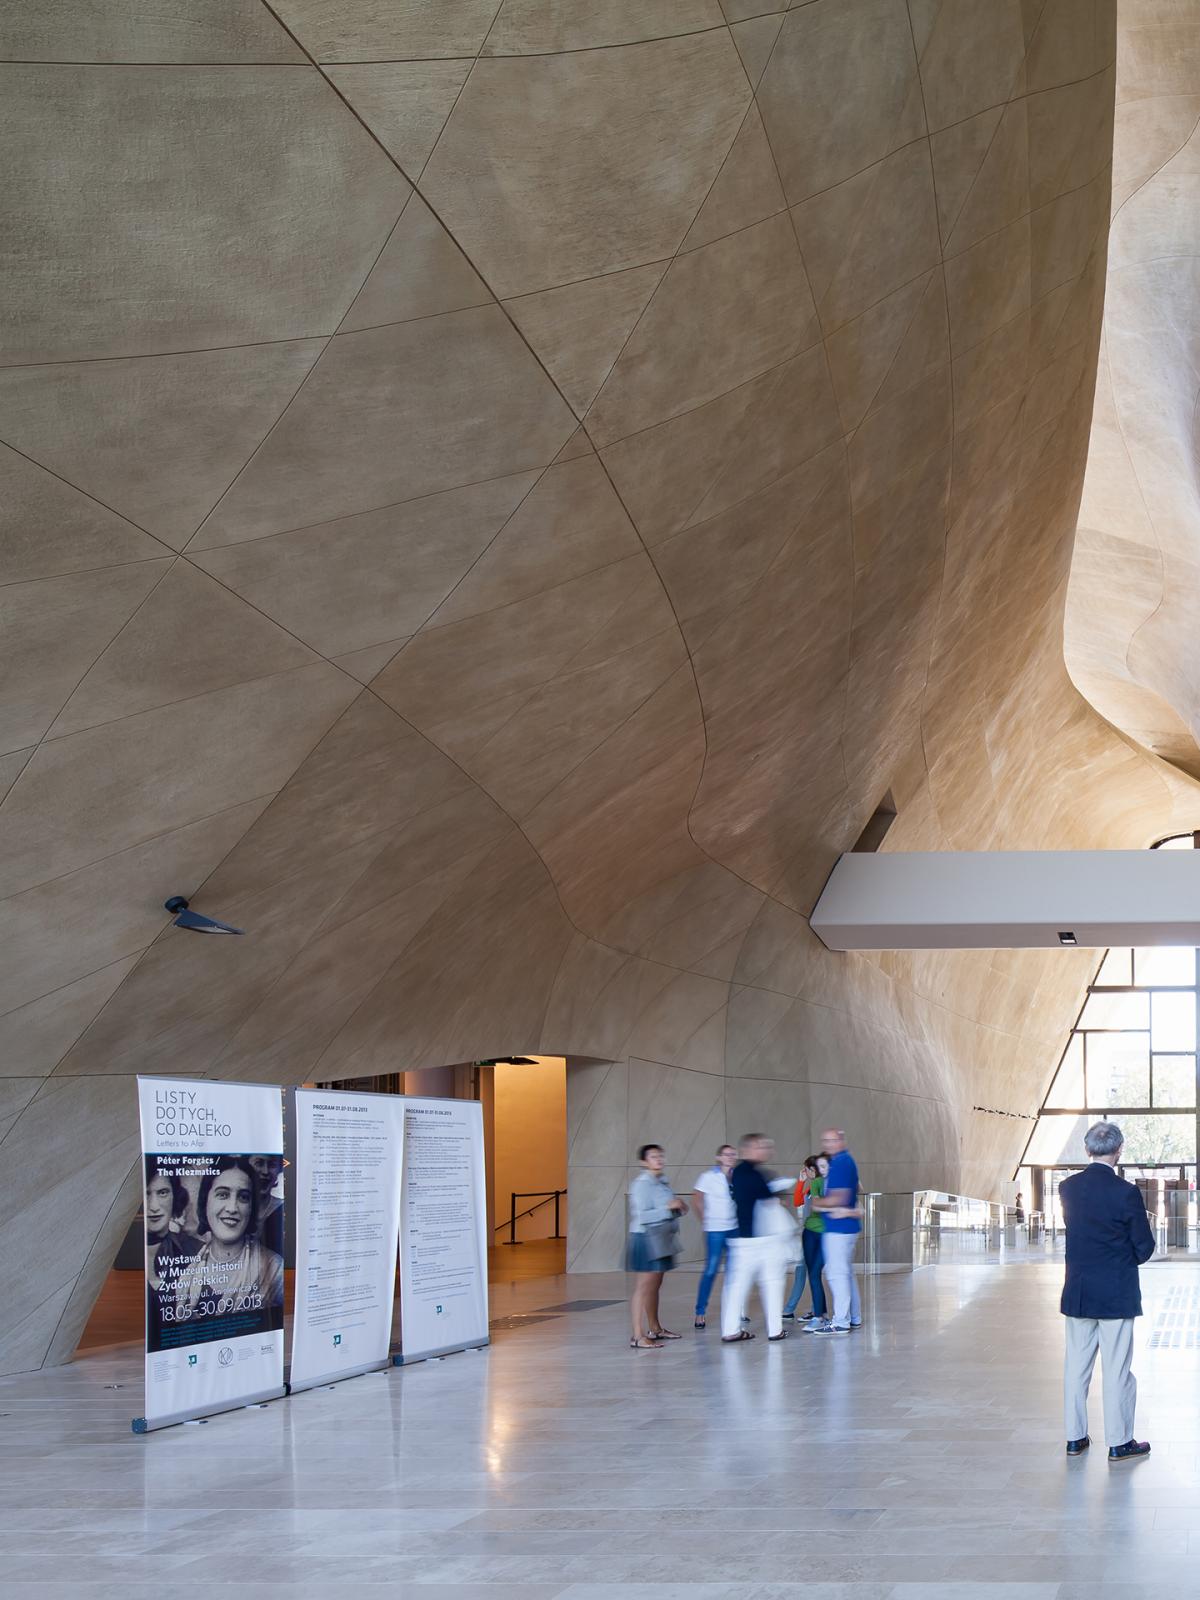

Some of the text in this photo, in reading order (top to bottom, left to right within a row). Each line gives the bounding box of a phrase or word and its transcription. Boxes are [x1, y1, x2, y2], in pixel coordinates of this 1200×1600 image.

[156, 1090, 196, 1104] LISTY
[156, 1106, 217, 1121] DO TYCH,
[156, 1123, 232, 1137] CO DALEKO
[157, 1156, 180, 1165] Péter
[182, 1157, 214, 1166] Forgács
[176, 1168, 220, 1176] Klezmatics
[158, 1255, 201, 1268] Wystawa
[169, 1266, 209, 1277] Muzeum
[211, 1260, 243, 1270] Historii
[159, 1275, 228, 1292] Żydów Polskich
[201, 1290, 210, 1298] ul.
